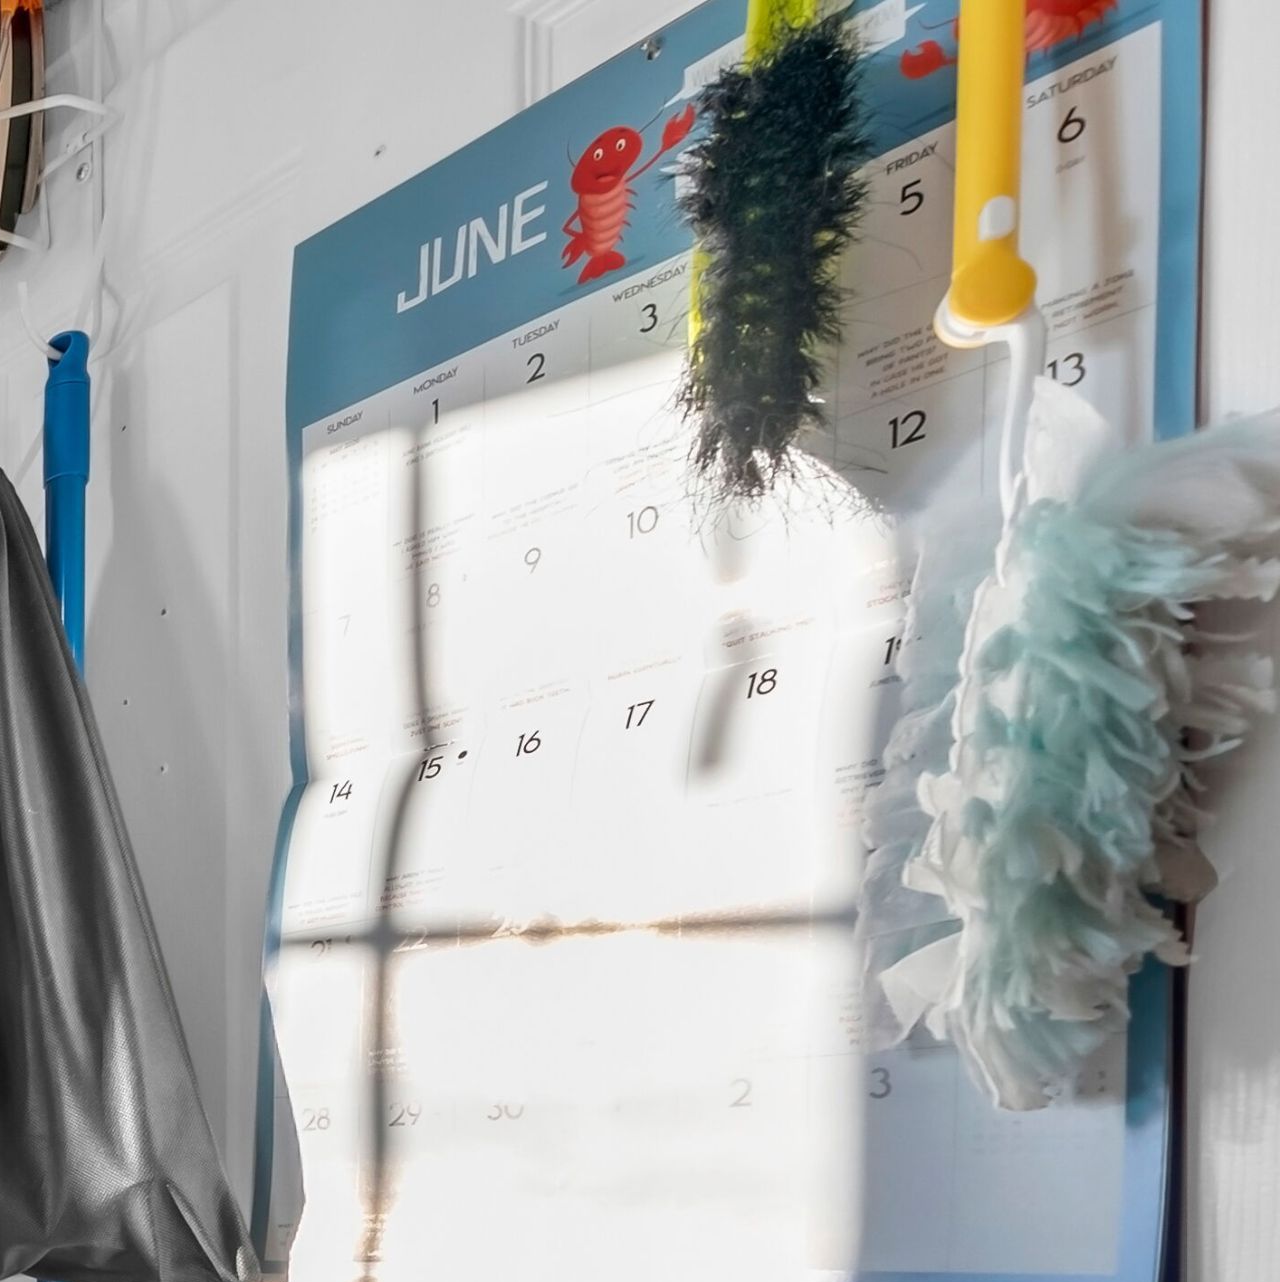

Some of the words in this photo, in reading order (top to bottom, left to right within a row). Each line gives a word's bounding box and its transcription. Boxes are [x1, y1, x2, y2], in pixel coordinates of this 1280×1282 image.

[1026, 57, 1117, 110] SATURDAY
[1056, 105, 1086, 144] 6
[885, 142, 939, 177] FRIDAY
[899, 179, 925, 216] 5
[397, 180, 549, 314] JUNE
[612, 263, 687, 303] WEDNESDAY
[639, 303, 658, 333] 3
[511, 319, 561, 349] TUESDAY
[413, 366, 458, 396] MONDAY
[526, 353, 546, 384] 2
[1046, 353, 1087, 387] 13
[326, 410, 364, 435] SUNDAY
[431, 399, 440, 425] 1
[888, 410, 927, 450] 12
[626, 505, 659, 539] 10
[524, 547, 542, 574] 9
[425, 583, 440, 608] 8
[339, 613, 353, 638] 7
[747, 668, 778, 699] 18
[623, 700, 656, 730] 17
[516, 730, 542, 757] 16
[418, 756, 444, 781] 15
[329, 780, 353, 804] 14
[729, 1079, 752, 1108] 2
[870, 1068, 892, 1100] 3
[303, 1107, 331, 1132] 28
[389, 1101, 423, 1128] 29
